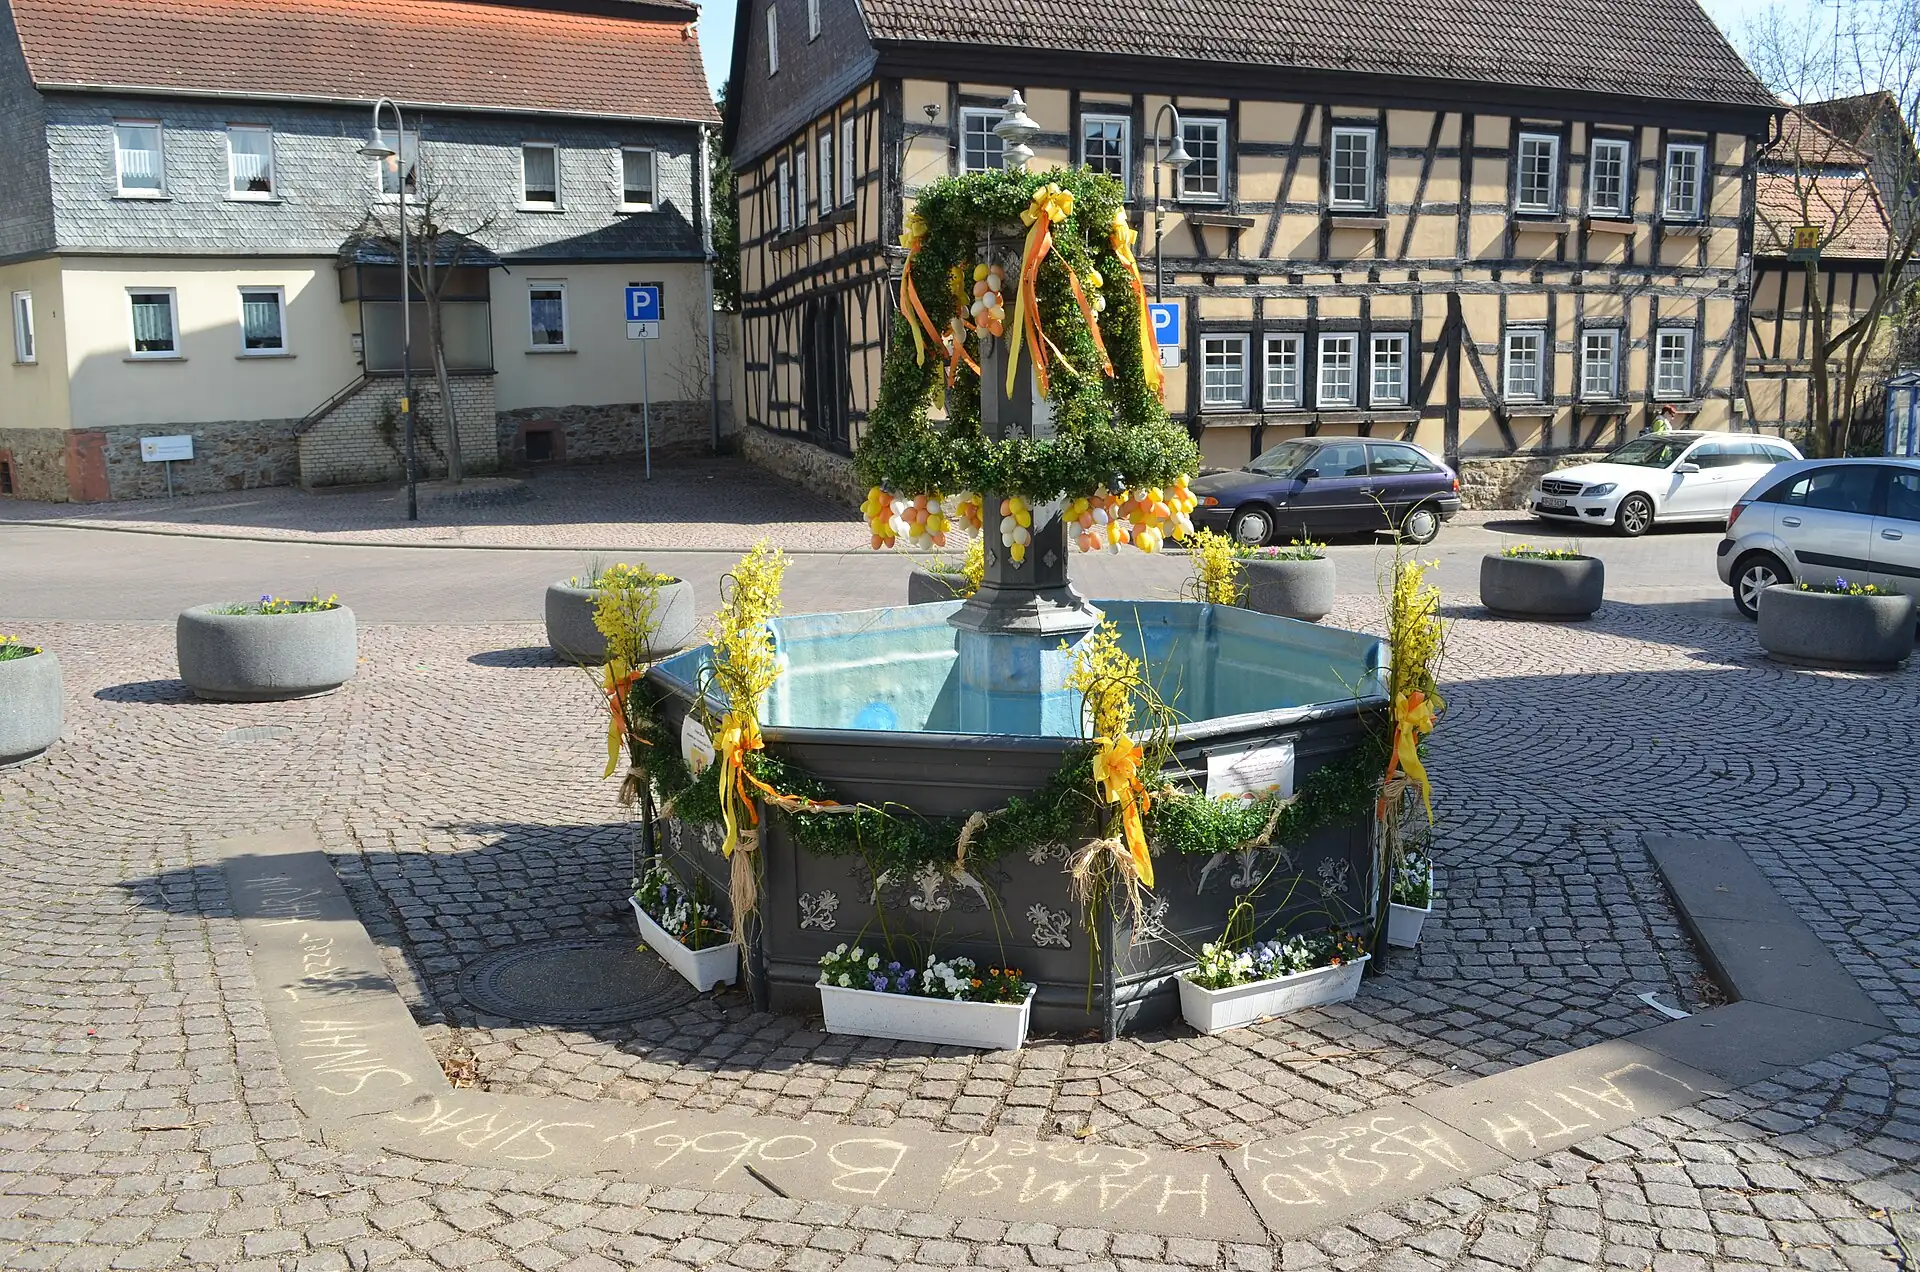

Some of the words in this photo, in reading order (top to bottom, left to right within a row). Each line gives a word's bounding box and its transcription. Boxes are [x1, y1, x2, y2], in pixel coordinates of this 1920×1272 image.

[632, 291, 651, 317] P
[1151, 308, 1171, 340] P
[297, 1018, 414, 1096] SINAH
[1481, 1063, 1694, 1150] LAITH
[602, 1119, 908, 1195] Bobby
[1261, 1119, 1472, 1205] ASSAD
